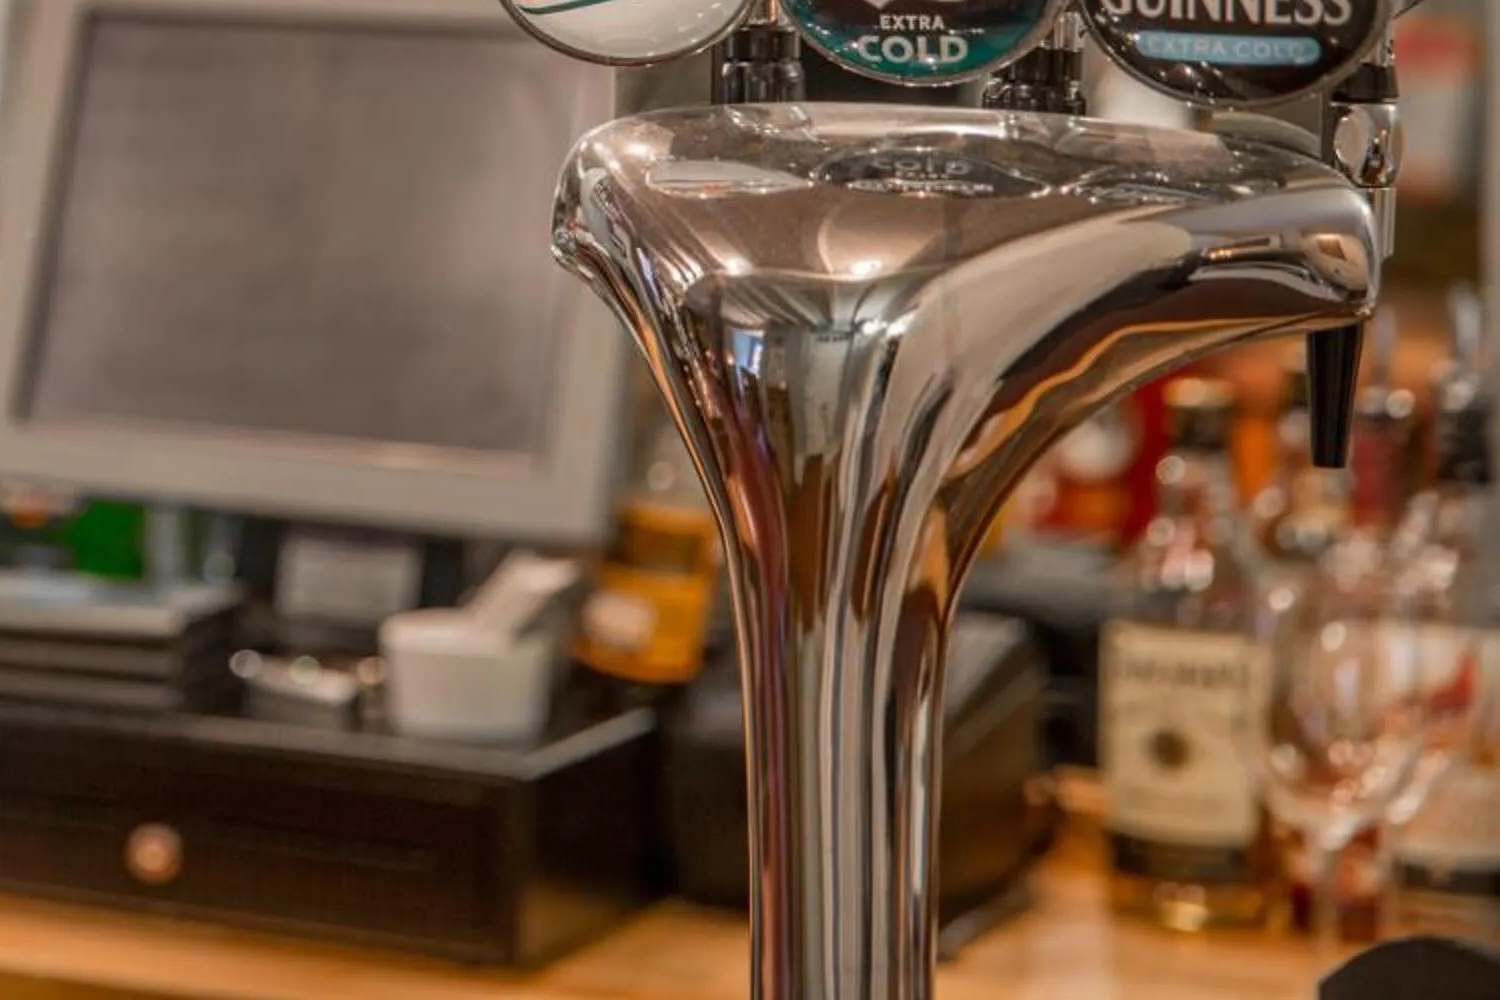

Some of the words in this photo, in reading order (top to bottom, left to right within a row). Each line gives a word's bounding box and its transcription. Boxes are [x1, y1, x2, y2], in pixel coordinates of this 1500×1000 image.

[879, 14, 946, 31] EXTRA
[856, 34, 970, 64] COLD
[1147, 34, 1226, 57] EXTRA
[1233, 40, 1308, 61] COLD
